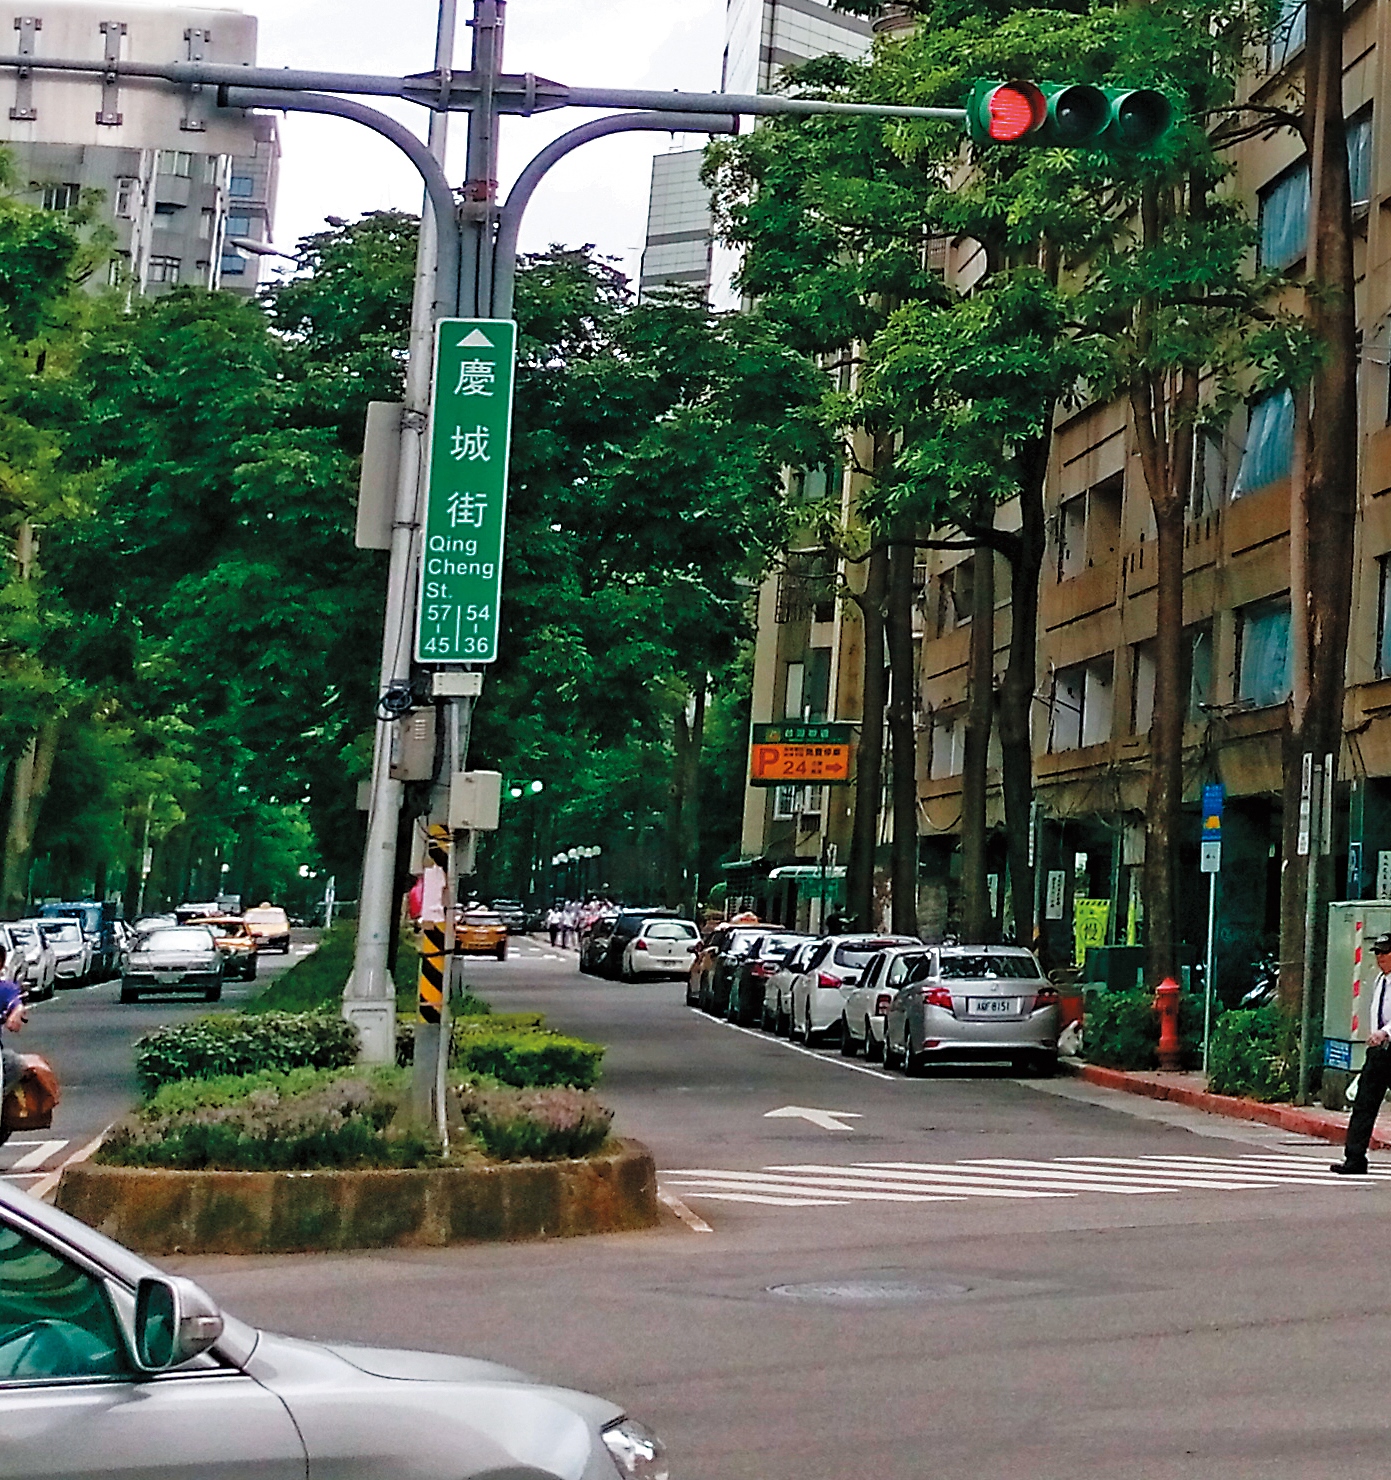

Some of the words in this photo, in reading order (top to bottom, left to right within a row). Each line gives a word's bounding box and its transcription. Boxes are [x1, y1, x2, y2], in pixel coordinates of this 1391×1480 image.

[447, 359, 497, 528] 慶城街
[429, 535, 477, 556] Qing
[428, 559, 495, 579] Cheng
[426, 582, 453, 599] St.
[427, 605, 451, 621] 57
[466, 605, 490, 621] 54
[424, 638, 450, 653] 45
[464, 637, 489, 653] 36
[759, 747, 780, 777] P
[783, 761, 807, 775] 24
